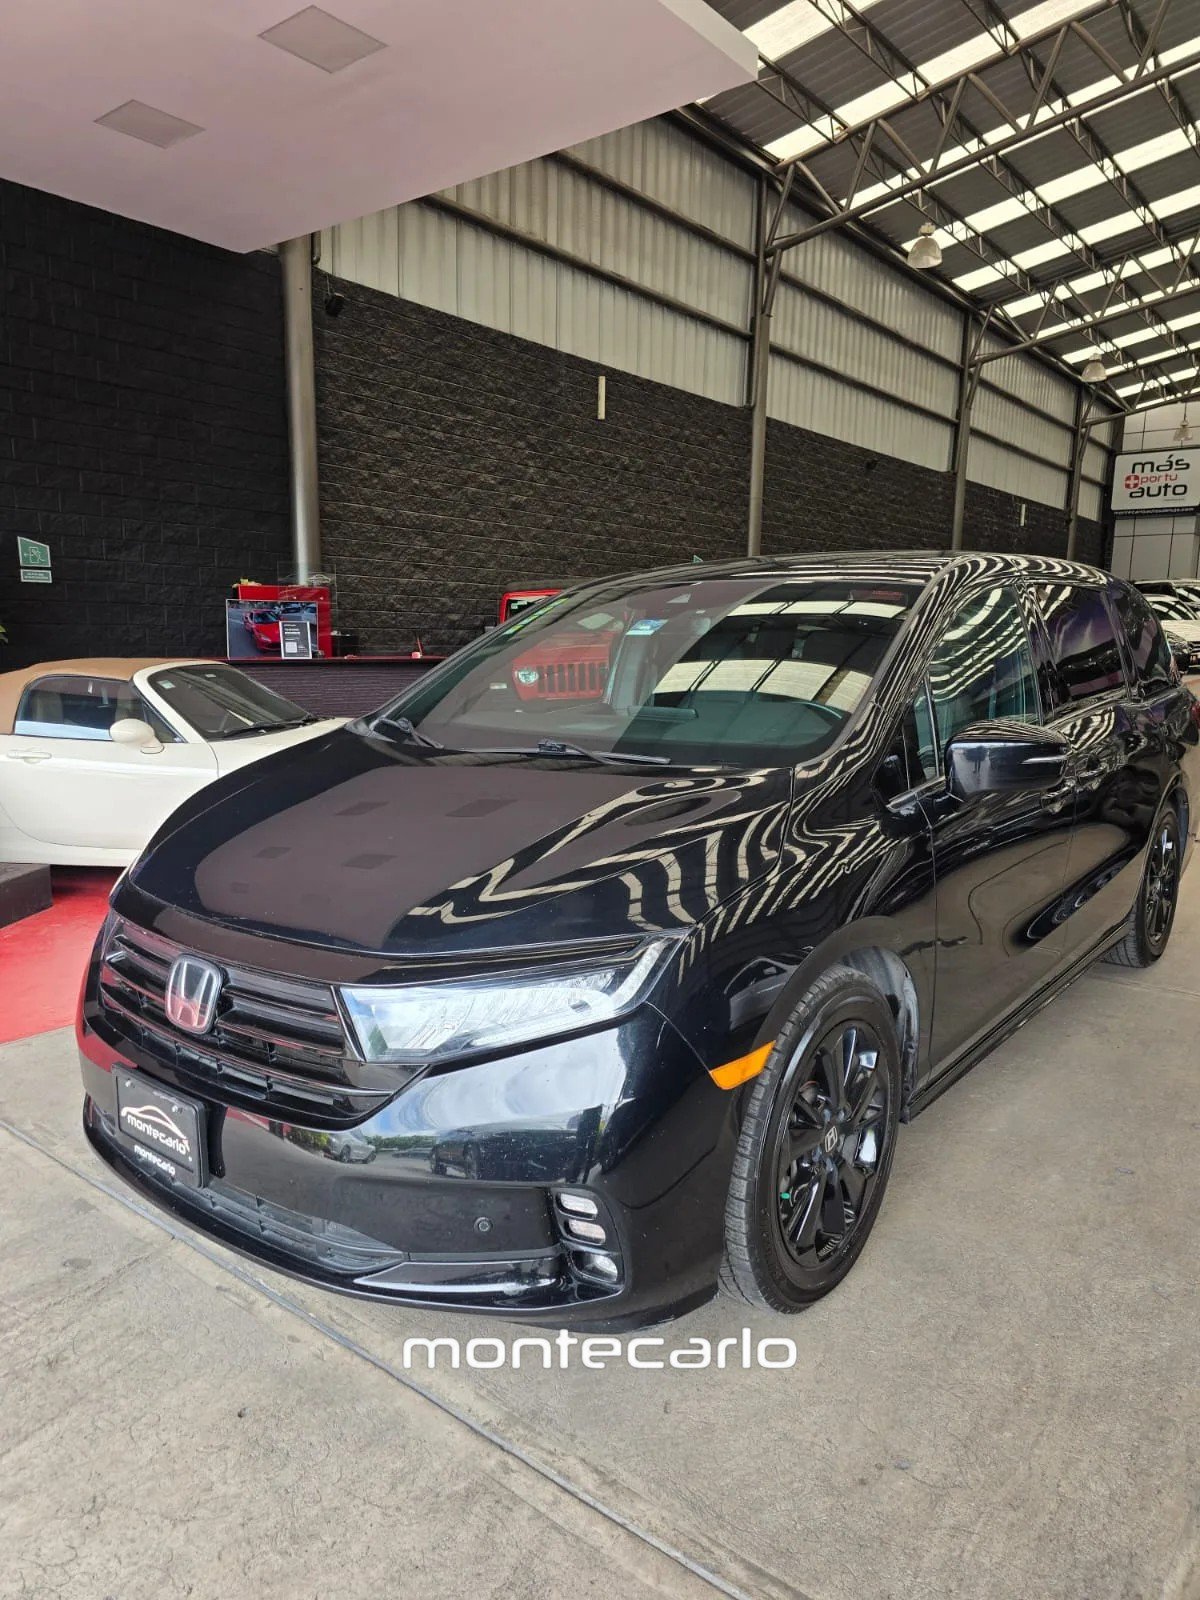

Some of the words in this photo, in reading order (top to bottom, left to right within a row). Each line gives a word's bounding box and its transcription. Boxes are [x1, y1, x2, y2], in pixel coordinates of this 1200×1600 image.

[1132, 454, 1190, 474] más
[1129, 483, 1187, 498] auto
[127, 1114, 186, 1155] montecarlo
[134, 1144, 176, 1176] montecarlo
